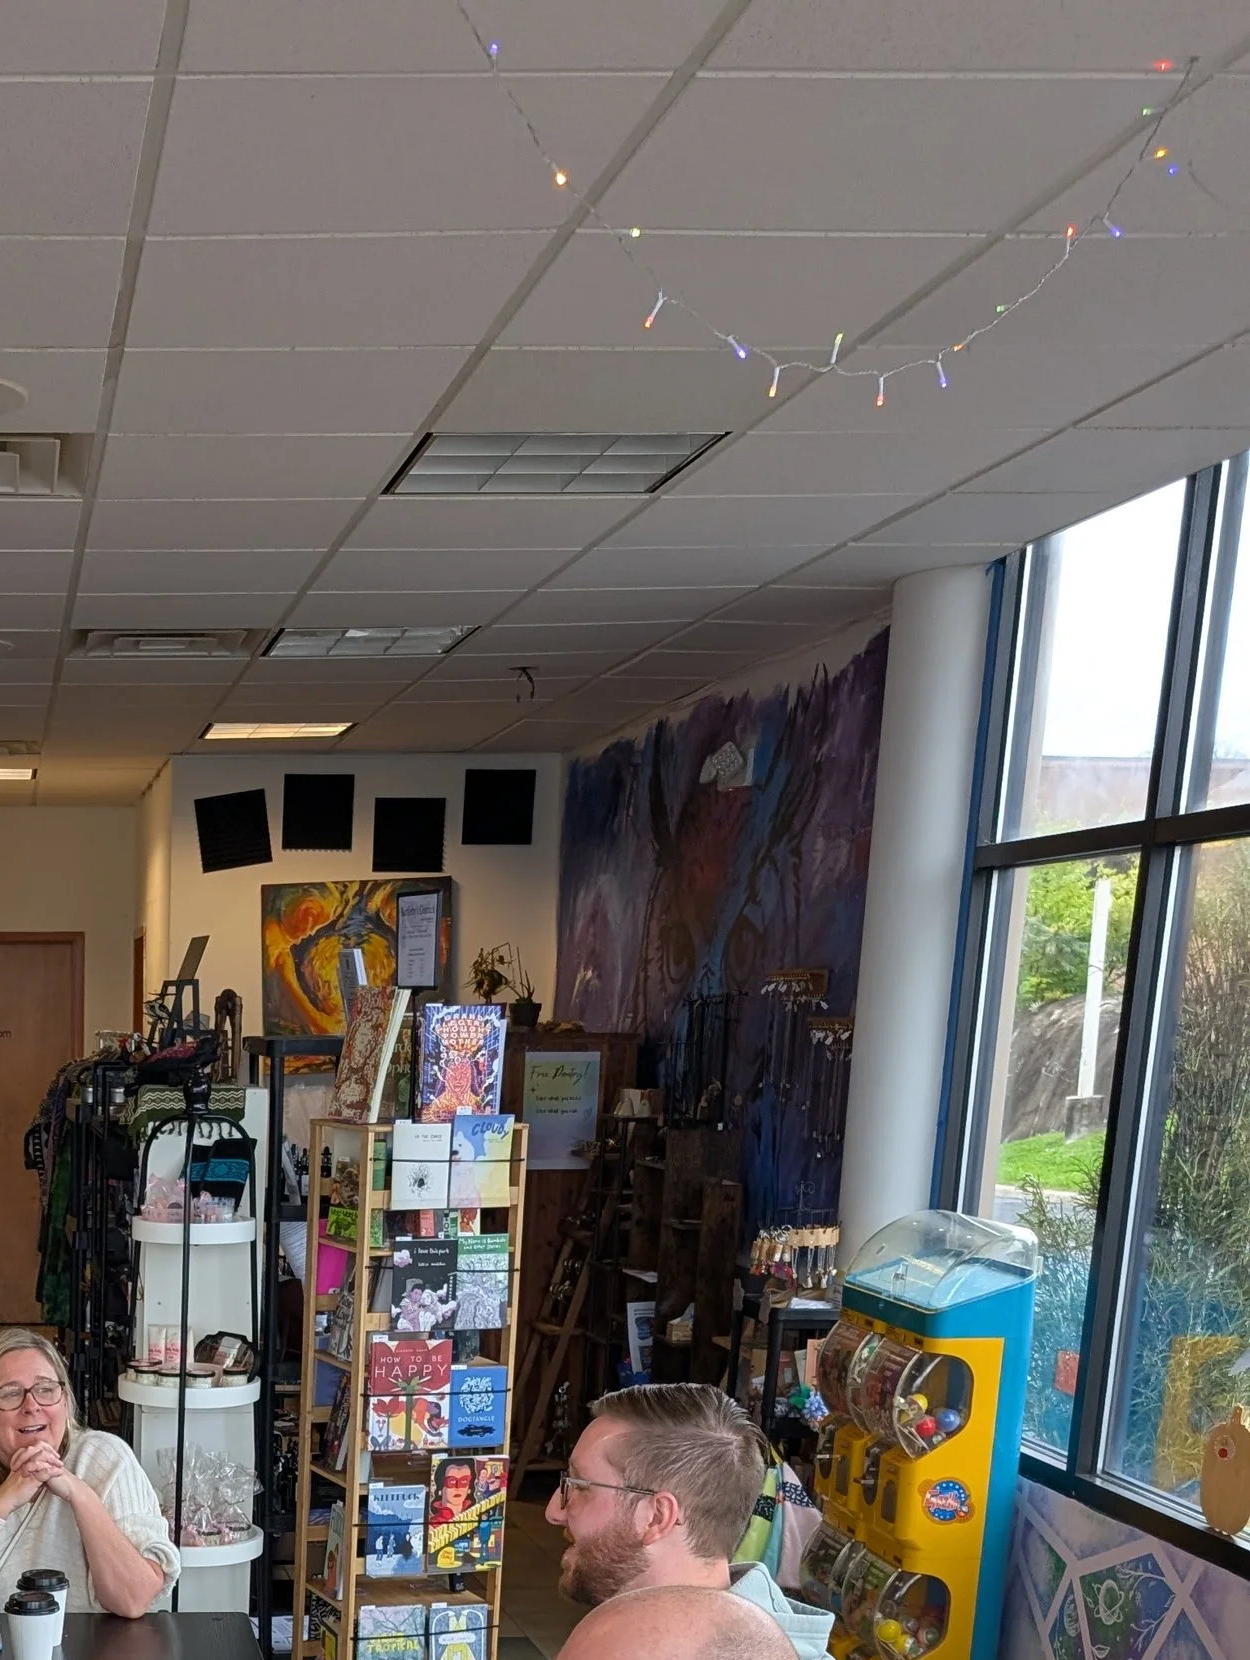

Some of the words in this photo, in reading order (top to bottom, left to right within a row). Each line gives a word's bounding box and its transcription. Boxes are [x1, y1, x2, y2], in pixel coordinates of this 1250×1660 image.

[530, 1065, 550, 1080] Free
[471, 1121, 510, 1139] CLOUDY
[375, 1364, 448, 1378] HAPPY
